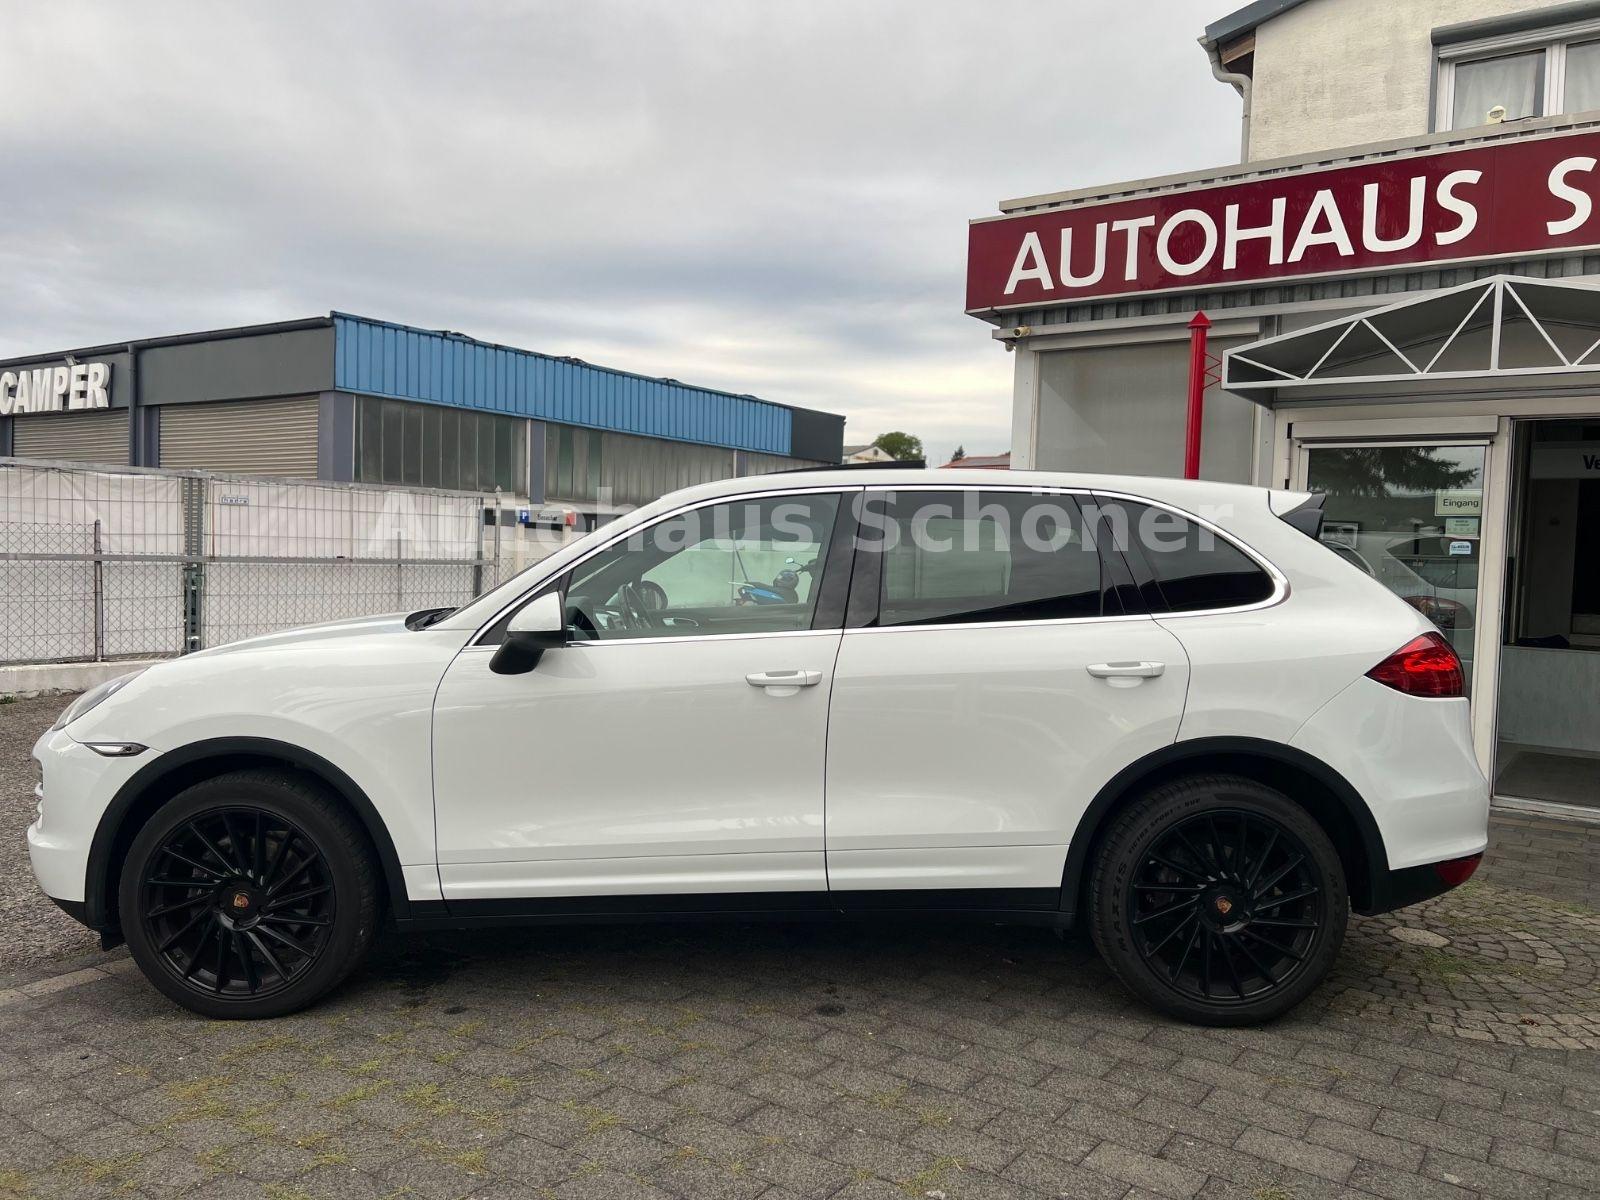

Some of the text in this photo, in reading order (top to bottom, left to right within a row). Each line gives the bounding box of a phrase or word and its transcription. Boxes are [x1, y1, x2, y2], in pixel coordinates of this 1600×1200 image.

[1003, 156, 1598, 296] AUTOHAUS S
[0, 362, 111, 415] CAMPER
[1443, 498, 1479, 508] Eingang
